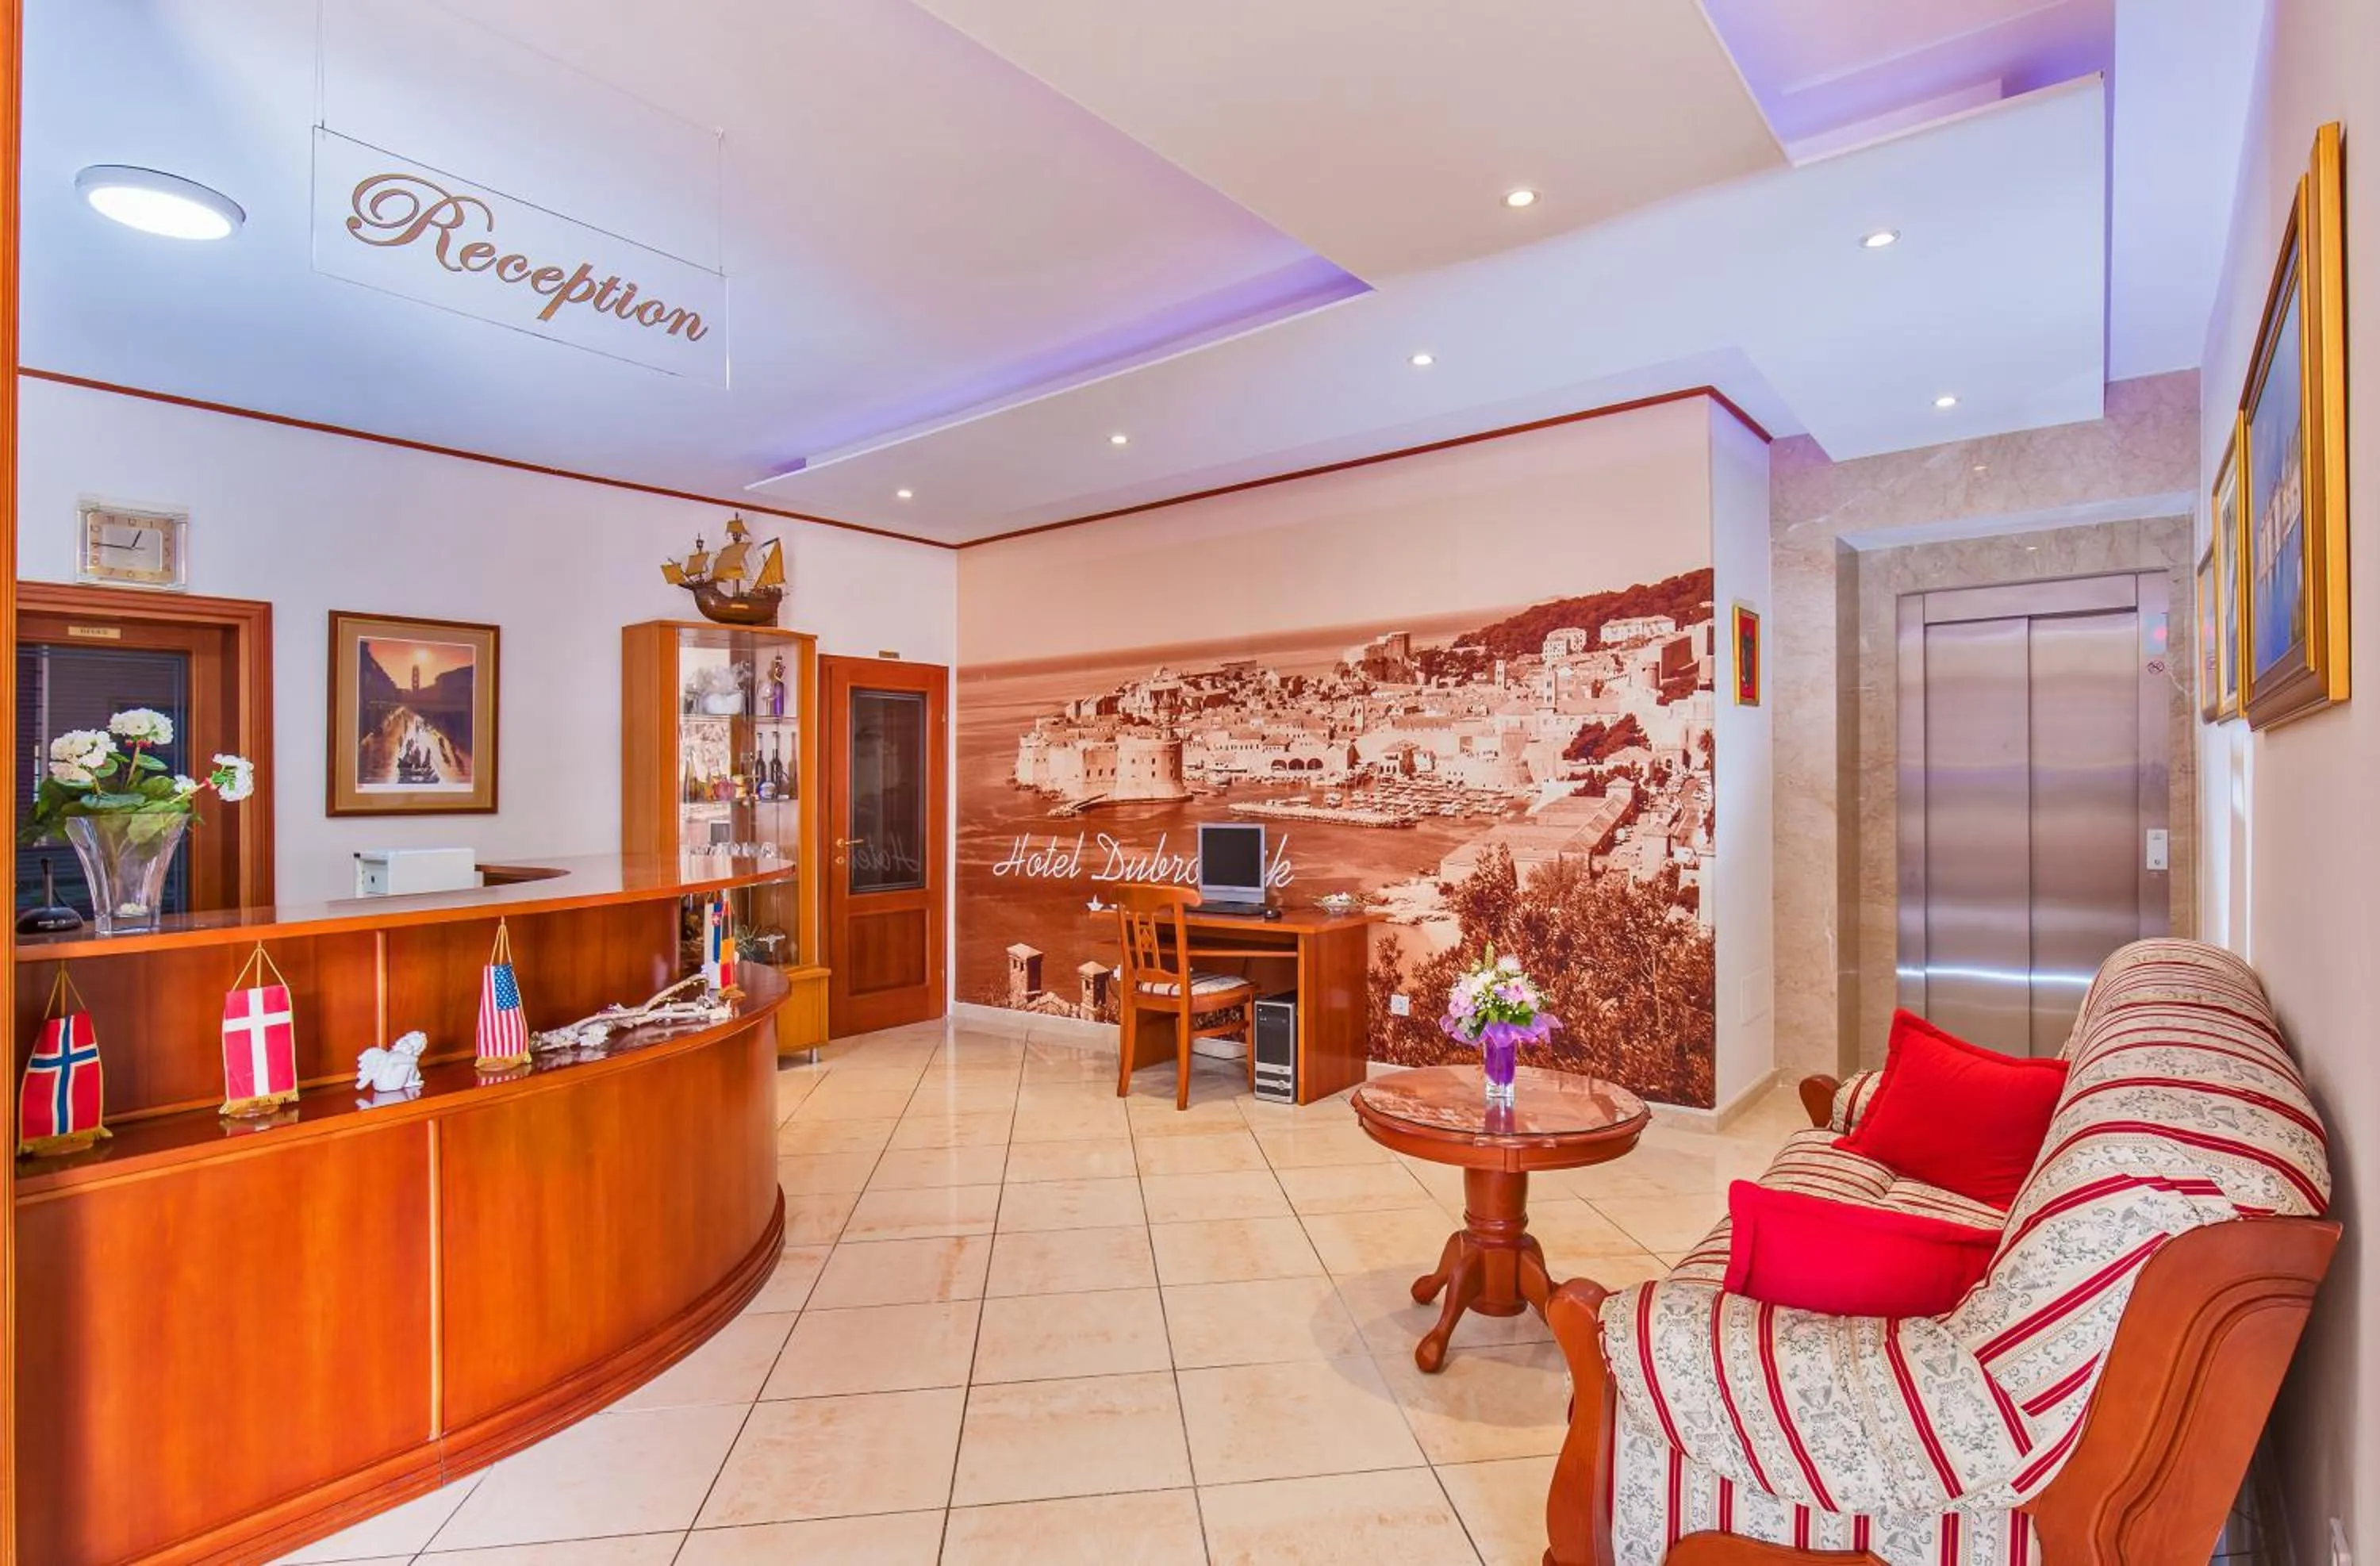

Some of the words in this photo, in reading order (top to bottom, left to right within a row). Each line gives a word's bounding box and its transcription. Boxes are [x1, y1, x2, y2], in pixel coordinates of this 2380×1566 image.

[346, 172, 708, 342] Reception
[992, 831, 1086, 879] Hotel
[1091, 831, 1295, 888] Dubrok
